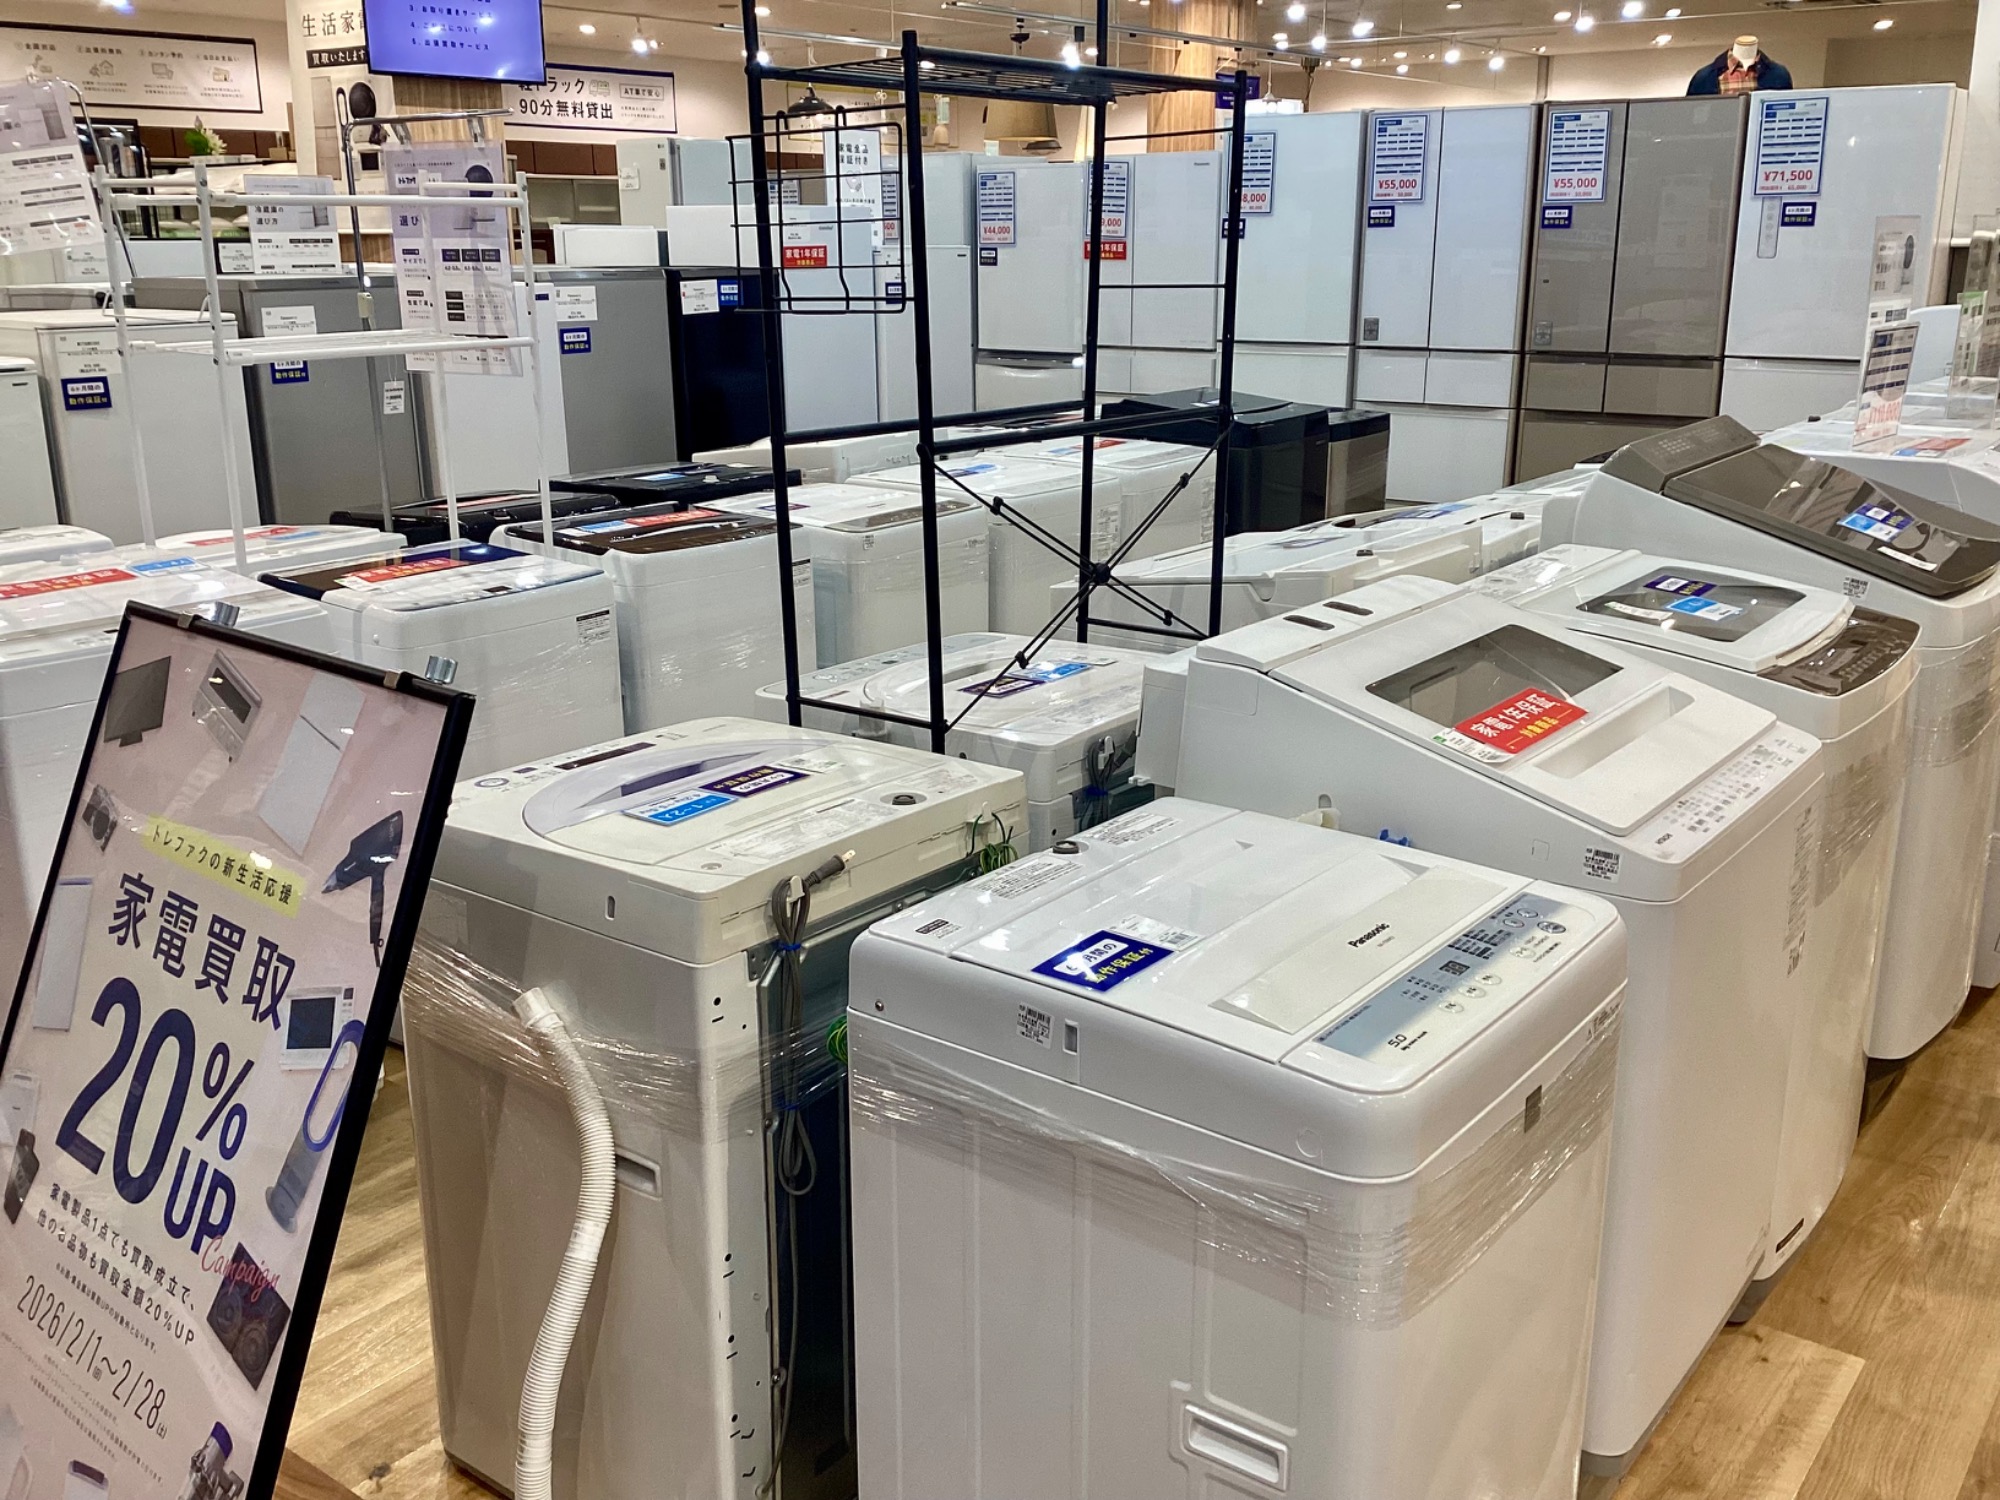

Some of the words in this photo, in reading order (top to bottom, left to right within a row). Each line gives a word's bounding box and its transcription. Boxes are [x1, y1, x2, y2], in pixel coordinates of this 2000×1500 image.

[312, 49, 366, 65] 買取いたします
[519, 98, 613, 119] 90分無料貸出
[1378, 179, 1417, 190] ¥55,000
[1553, 178, 1597, 189] ¥55,000
[1764, 170, 1813, 182] ¥71,500
[1242, 193, 1267, 203] 8,000
[983, 226, 1011, 235] ¥44,000
[1101, 218, 1122, 228] 9,000
[785, 248, 825, 258] 家電1年保証
[1470, 693, 1561, 738] 家電1年保証
[153, 825, 292, 905] トレファクの新生活応援
[1348, 923, 1390, 948] Panasonic
[108, 873, 296, 1031] 家電買取
[55, 977, 255, 1204] 20%
[164, 1146, 236, 1254] UP
[201, 1234, 281, 1302] Campaign
